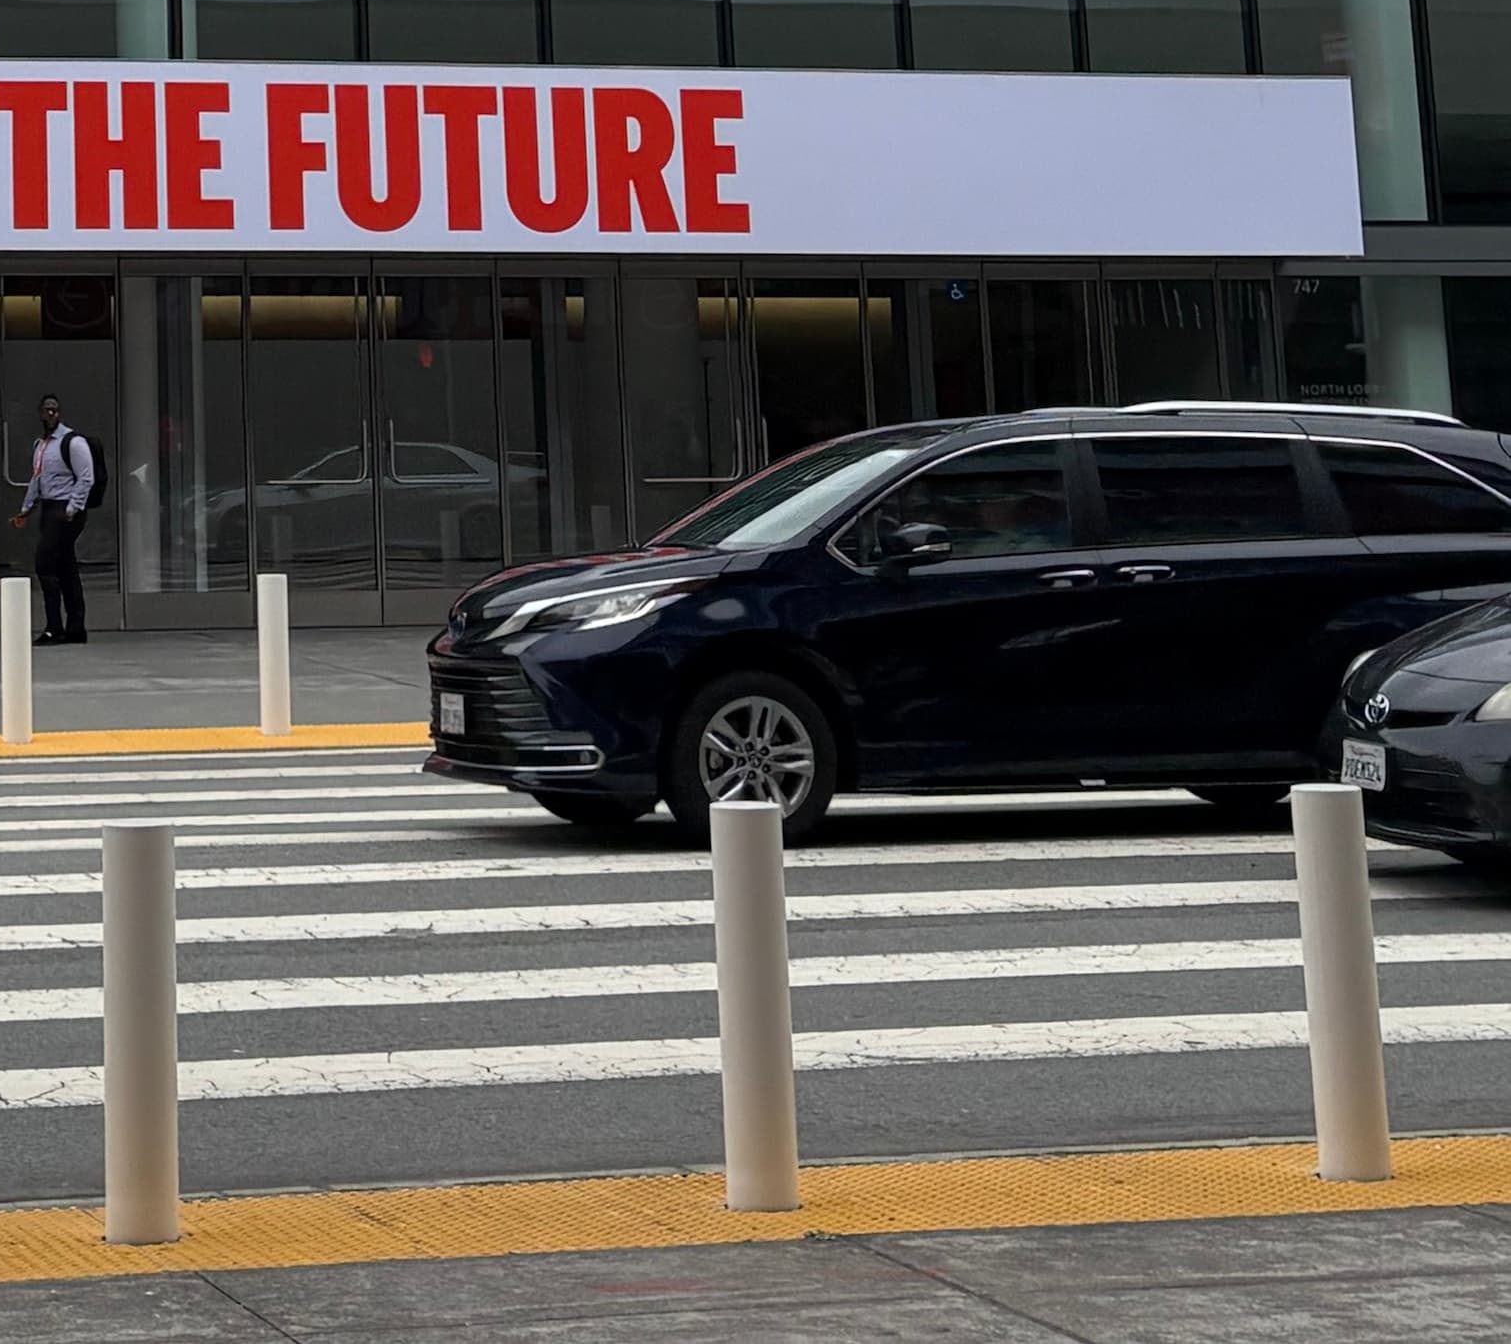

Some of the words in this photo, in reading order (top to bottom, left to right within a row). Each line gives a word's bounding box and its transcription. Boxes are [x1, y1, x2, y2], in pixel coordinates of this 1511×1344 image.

[265, 83, 751, 234] FUTURE
[1291, 278, 1320, 295] 747
[1300, 384, 1345, 397] NORTH
